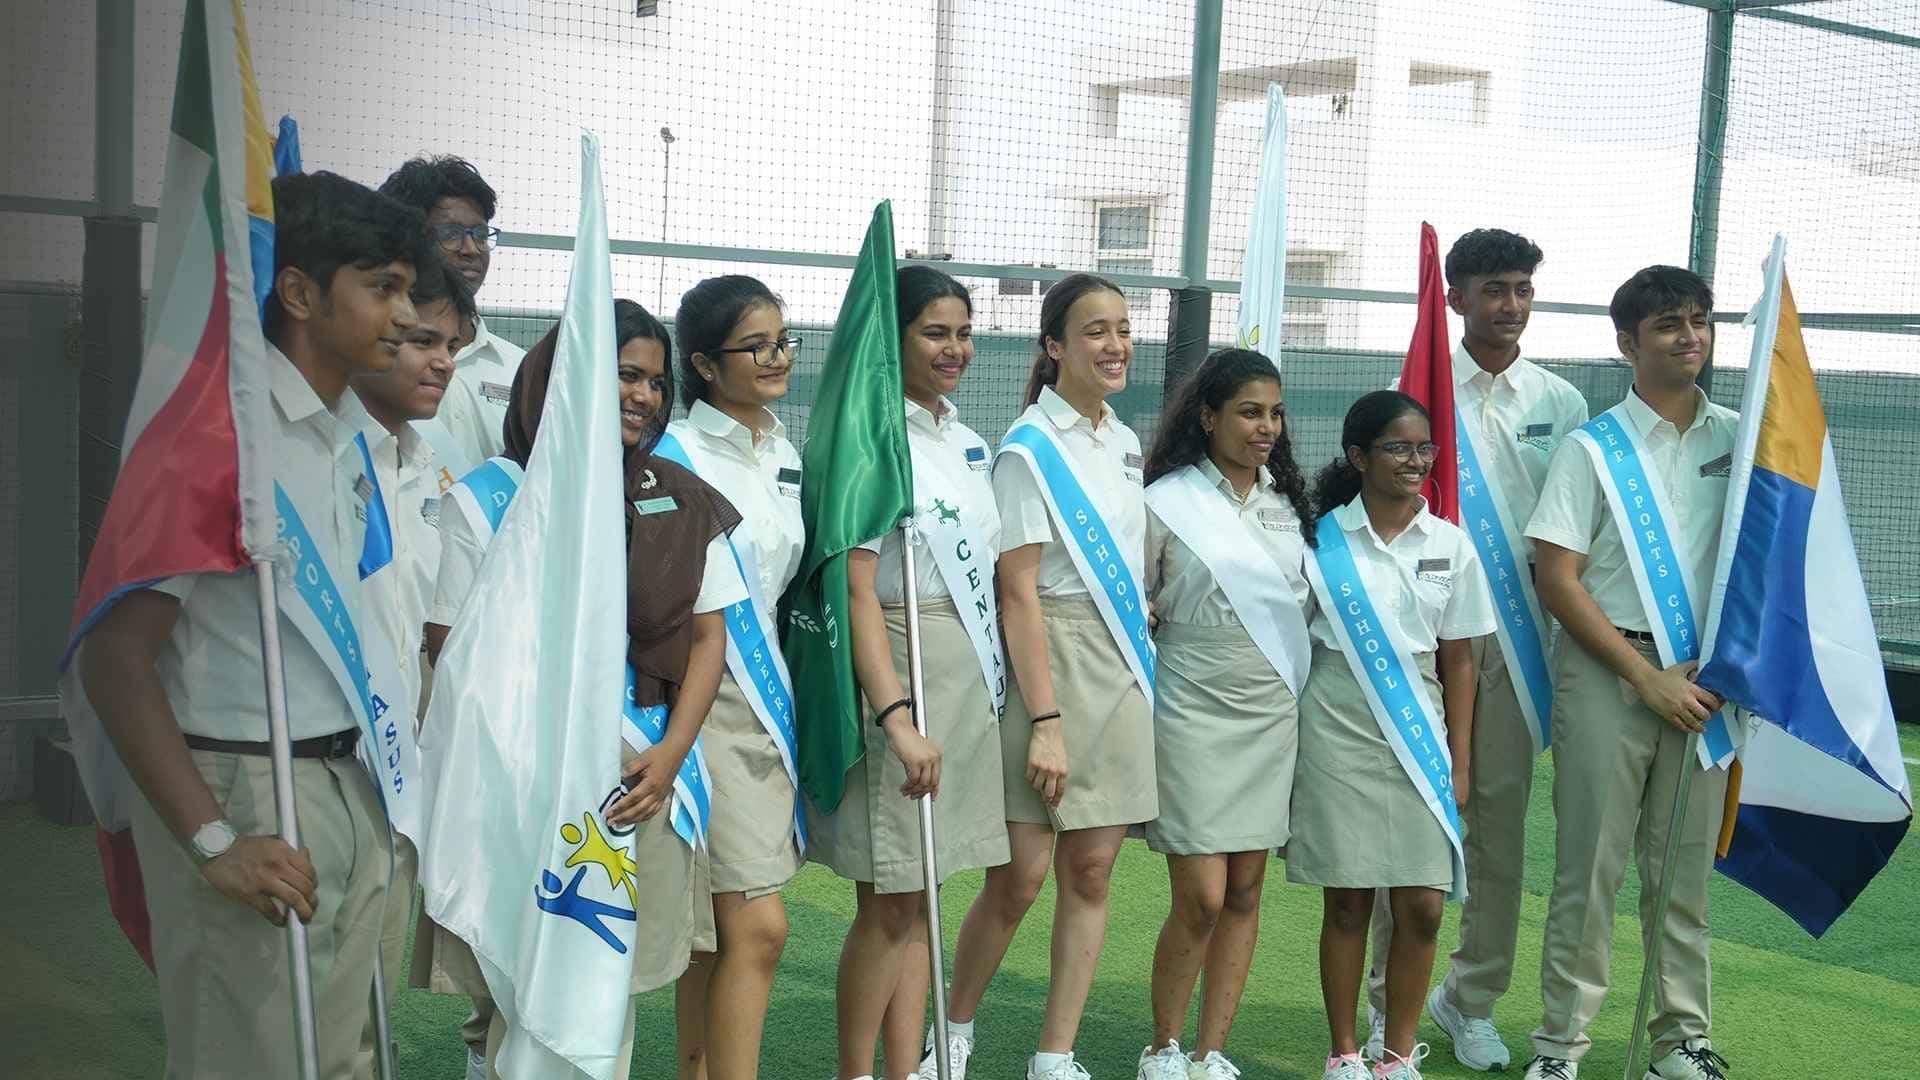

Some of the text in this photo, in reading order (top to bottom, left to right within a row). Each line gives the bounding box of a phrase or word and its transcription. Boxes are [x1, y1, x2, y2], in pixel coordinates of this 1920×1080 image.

[1075, 509, 1134, 612] SCHOOL
[1596, 421, 1623, 464] DEP
[1627, 477, 1669, 578] SPORTS
[1479, 518, 1524, 627] AFFAIRS
[1340, 582, 1453, 804] SCHOOL EDITOR
